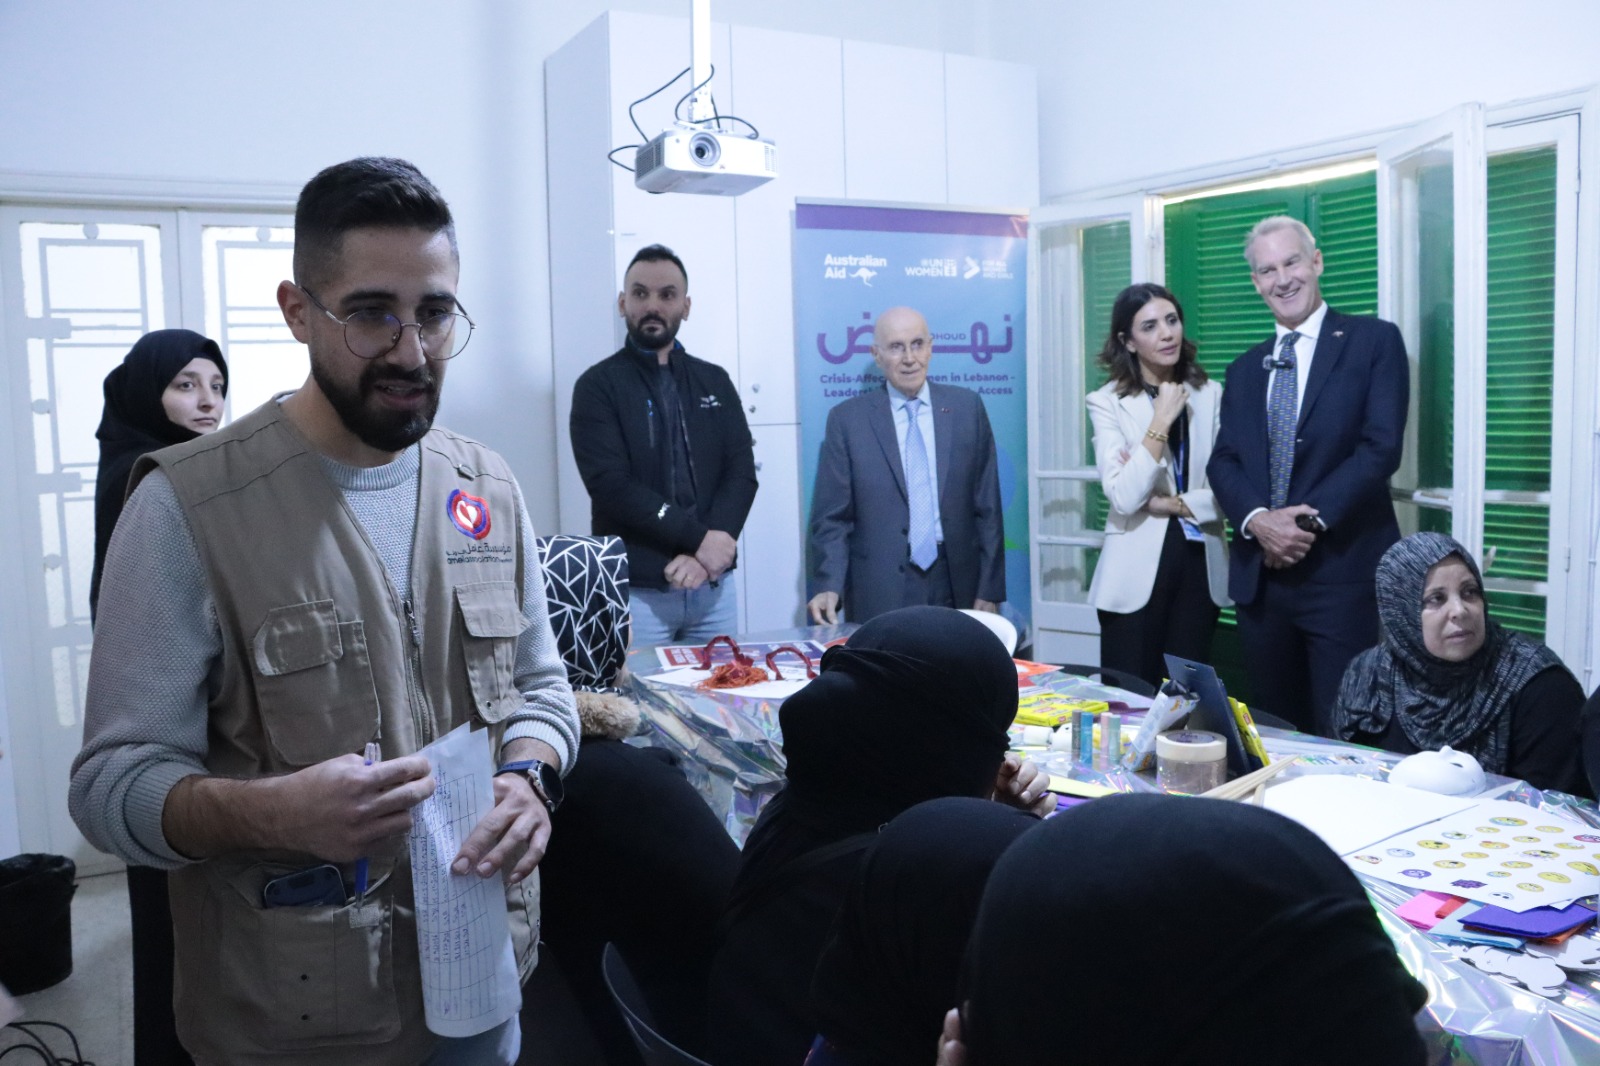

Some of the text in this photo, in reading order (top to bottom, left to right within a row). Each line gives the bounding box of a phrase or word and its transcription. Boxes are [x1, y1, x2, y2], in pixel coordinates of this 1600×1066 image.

[824, 253, 887, 267] Australian
[929, 258, 943, 267] UN
[824, 267, 846, 279] Aid
[905, 266, 943, 277] WOMEN
[820, 373, 885, 384] Crisis-Affec
[926, 373, 948, 382] men
[951, 372, 960, 382] in
[964, 372, 1009, 382] Lebanon
[977, 386, 1013, 395] Access
